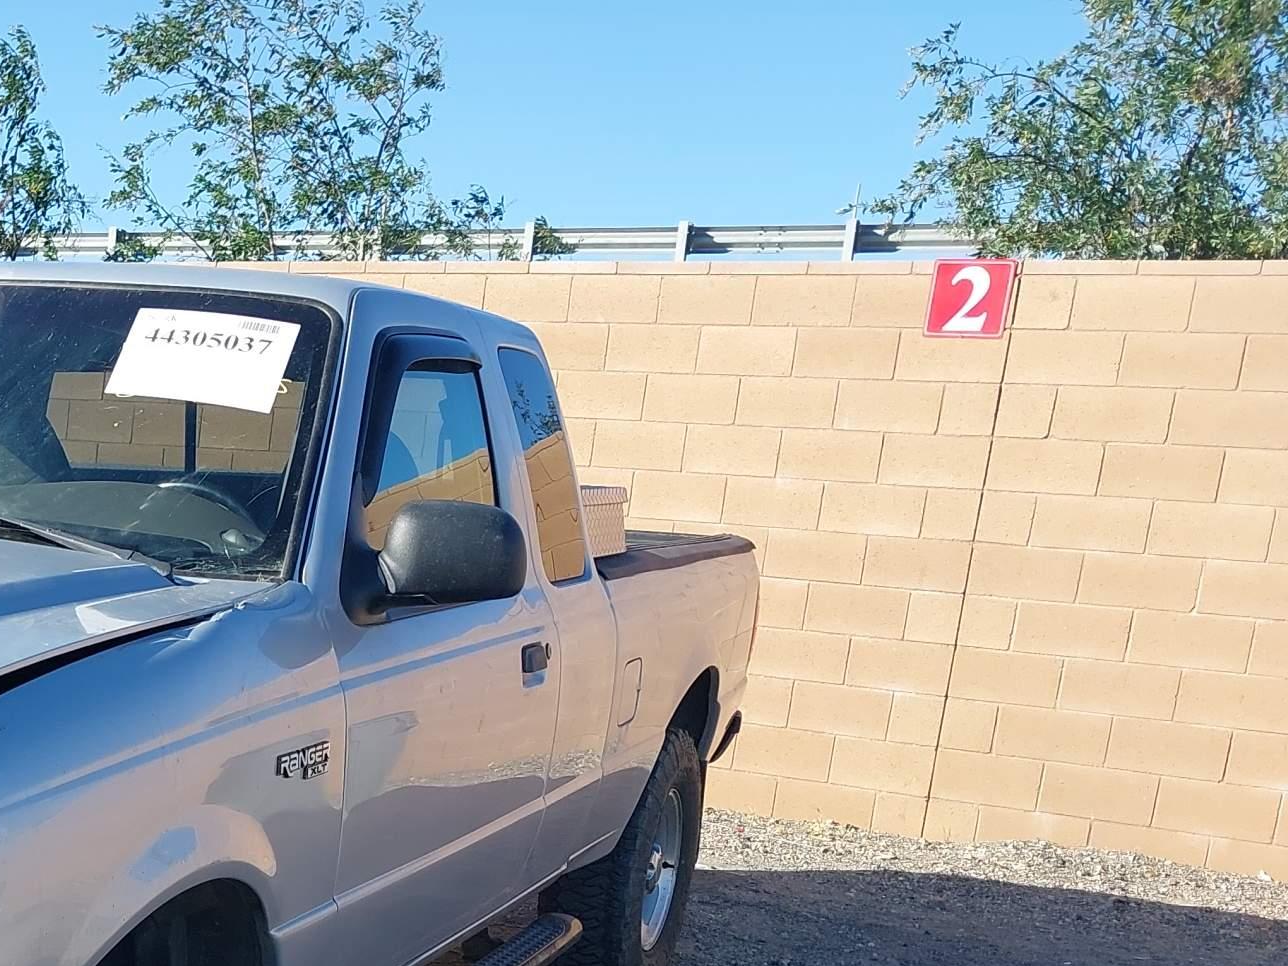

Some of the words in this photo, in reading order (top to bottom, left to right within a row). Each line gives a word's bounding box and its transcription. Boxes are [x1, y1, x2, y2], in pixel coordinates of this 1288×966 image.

[941, 266, 991, 332] 2
[144, 327, 273, 355] 44305037
[310, 763, 328, 776] XLT
